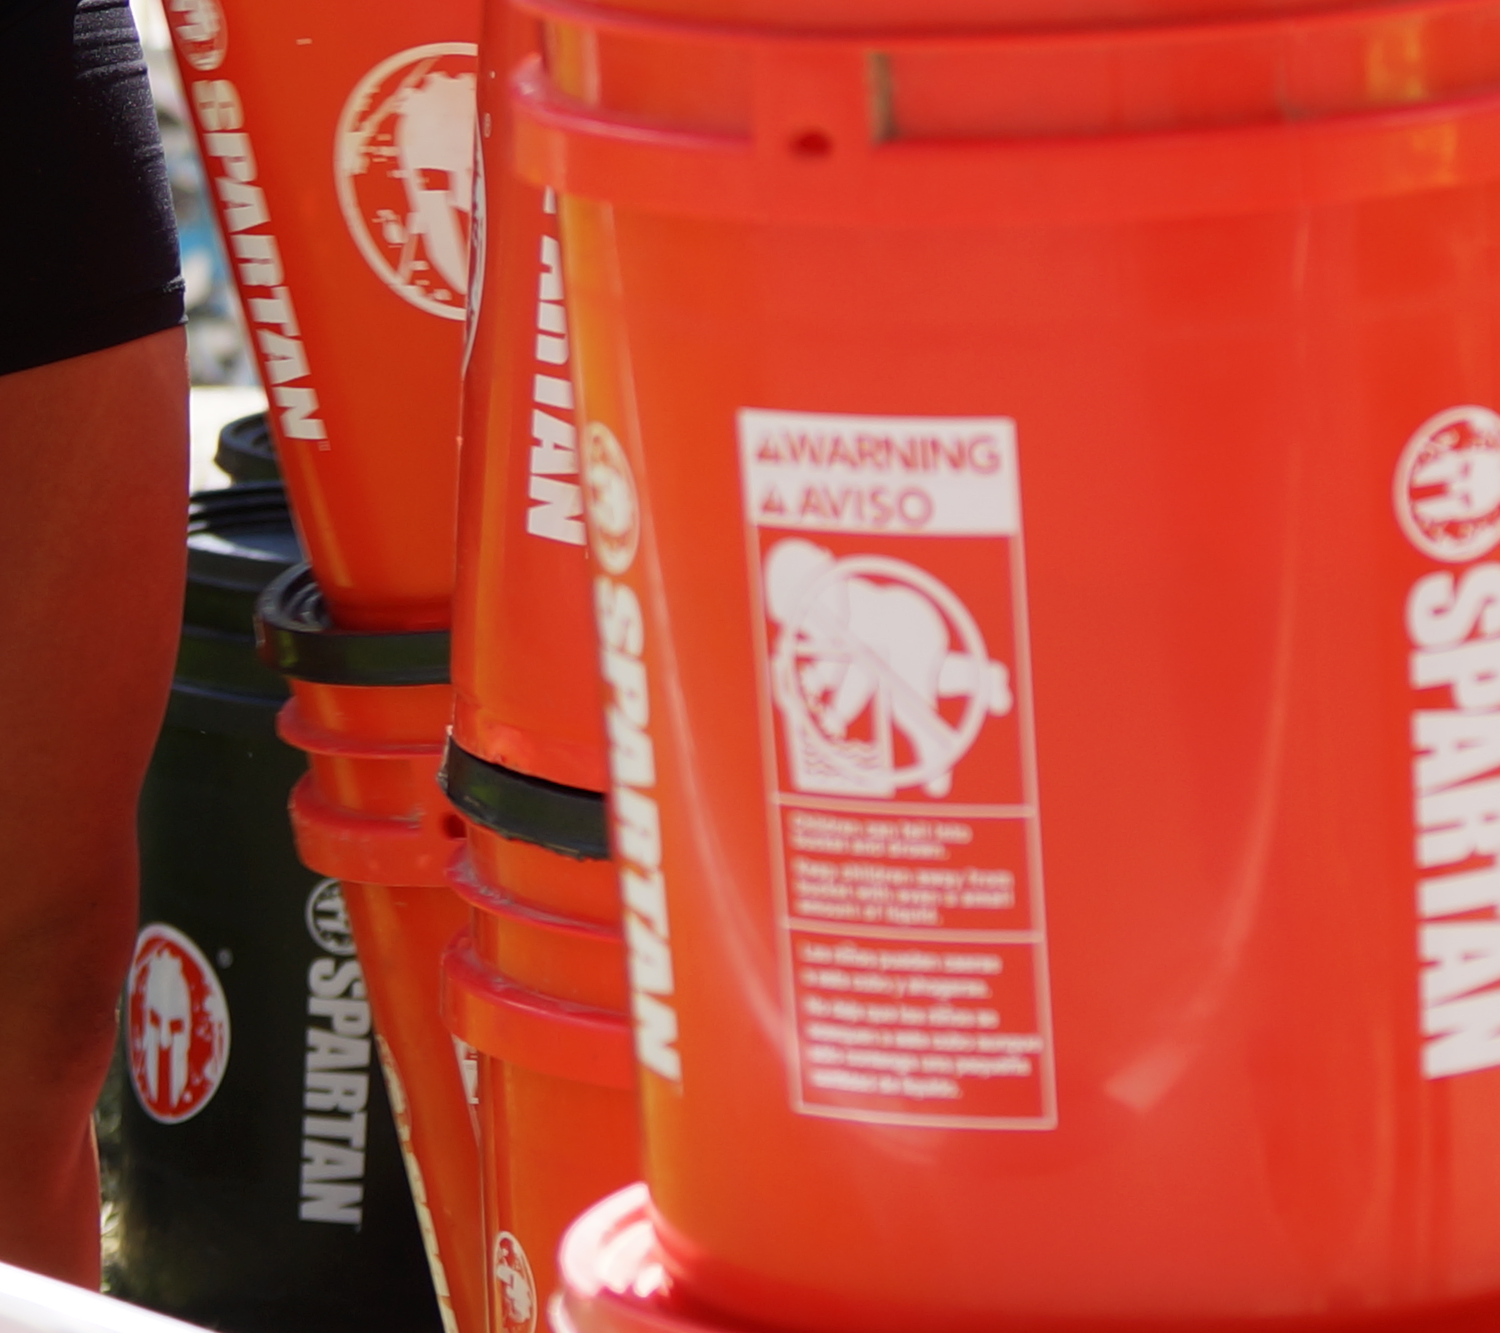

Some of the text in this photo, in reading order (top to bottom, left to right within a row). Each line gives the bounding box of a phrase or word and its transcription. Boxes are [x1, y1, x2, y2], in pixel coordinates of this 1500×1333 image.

[192, 79, 326, 442] SPARTAN
[786, 429, 1000, 475] WARNING
[800, 484, 933, 527] AVISO
[591, 578, 681, 1082] SPARTAN
[298, 956, 373, 1226] SPARTAN
